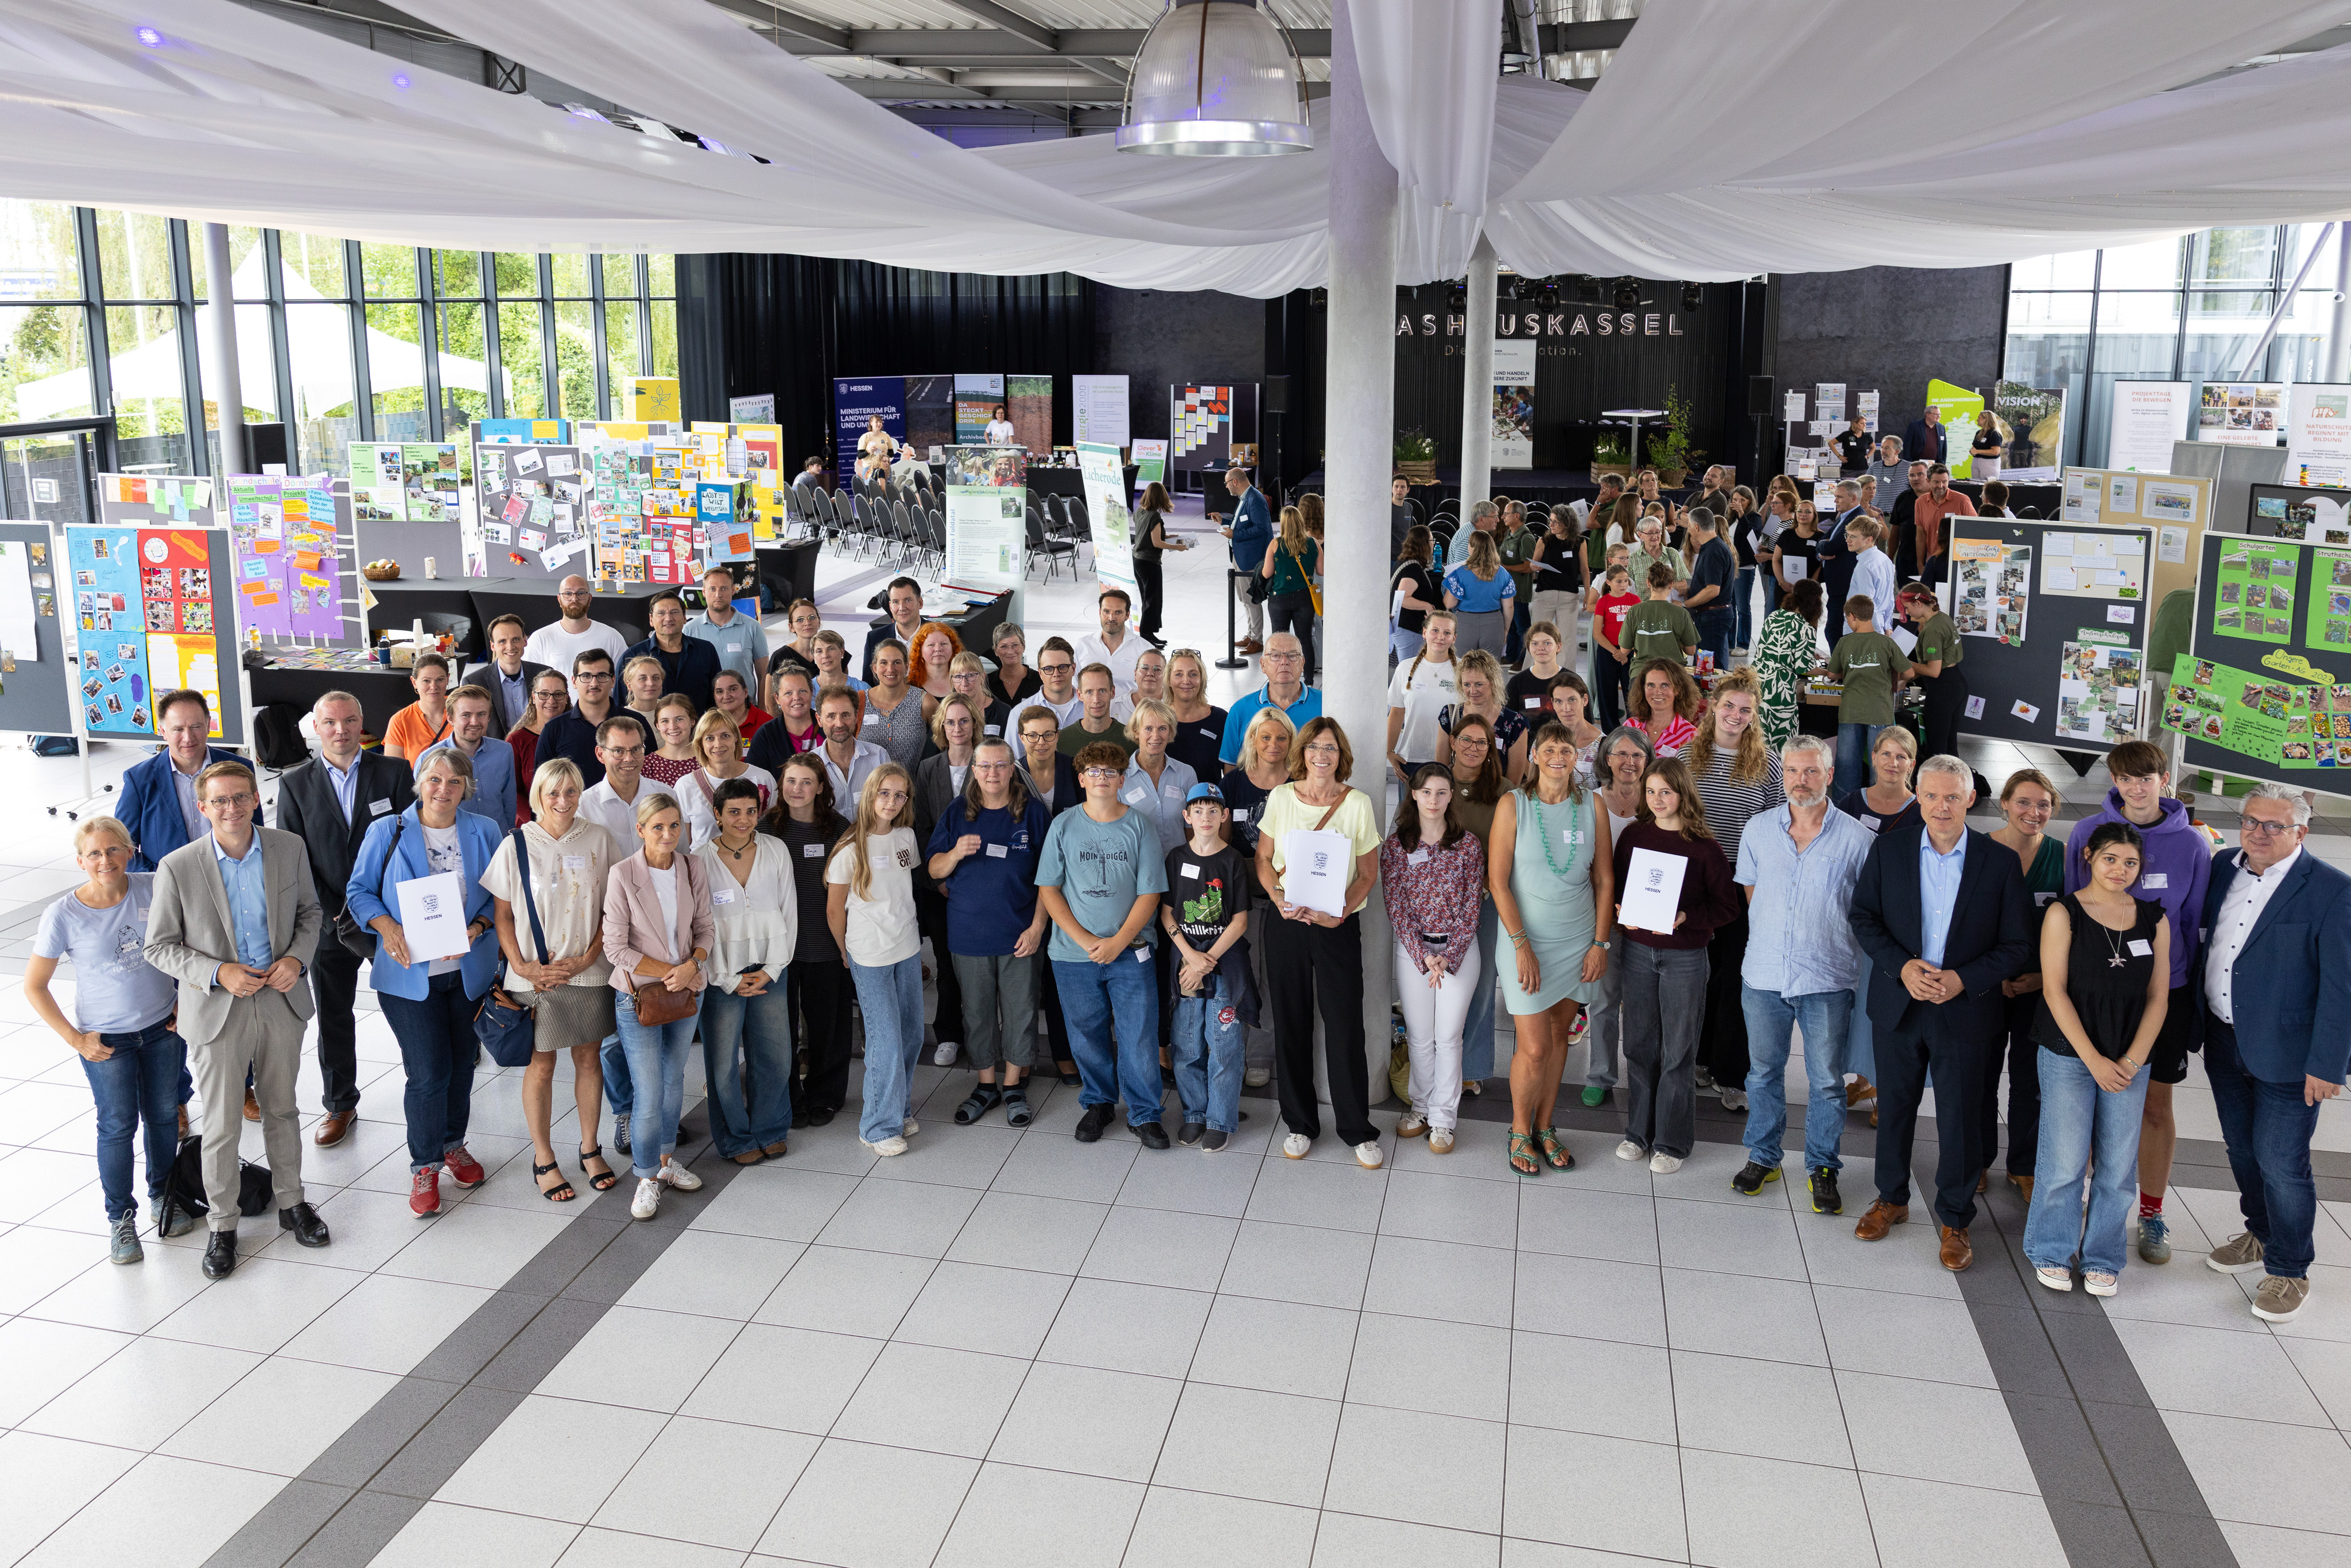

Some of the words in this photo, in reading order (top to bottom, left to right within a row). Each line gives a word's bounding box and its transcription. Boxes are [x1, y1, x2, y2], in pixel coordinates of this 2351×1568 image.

[1997, 396, 2040, 407] VISION
[840, 413, 900, 422] LANDWIRCHAFT
[1078, 385, 1088, 441] nergie2000
[1083, 466, 1122, 486] Licherode
[285, 479, 322, 488] Dörnberg
[311, 506, 335, 514] Kakaobohne
[173, 535, 203, 558] Erpetalschule
[1956, 543, 2001, 553] Jahreszeitliche
[2239, 542, 2276, 551] Schulgarten
[2316, 550, 2351, 558] Struthschu
[1609, 605, 1621, 614] TOMMY
[1621, 605, 1632, 614] JEAN
[2081, 630, 2128, 640] Außerschulische
[2275, 650, 2303, 665] Unsere
[2311, 672, 2333, 683] 2023
[2256, 721, 2270, 729] Tomaten
[897, 849, 910, 860] am
[1080, 851, 1099, 863] MOIN
[1106, 851, 1128, 862] DIGGA
[117, 956, 129, 965] AUF
[113, 962, 138, 973] FLACHER
